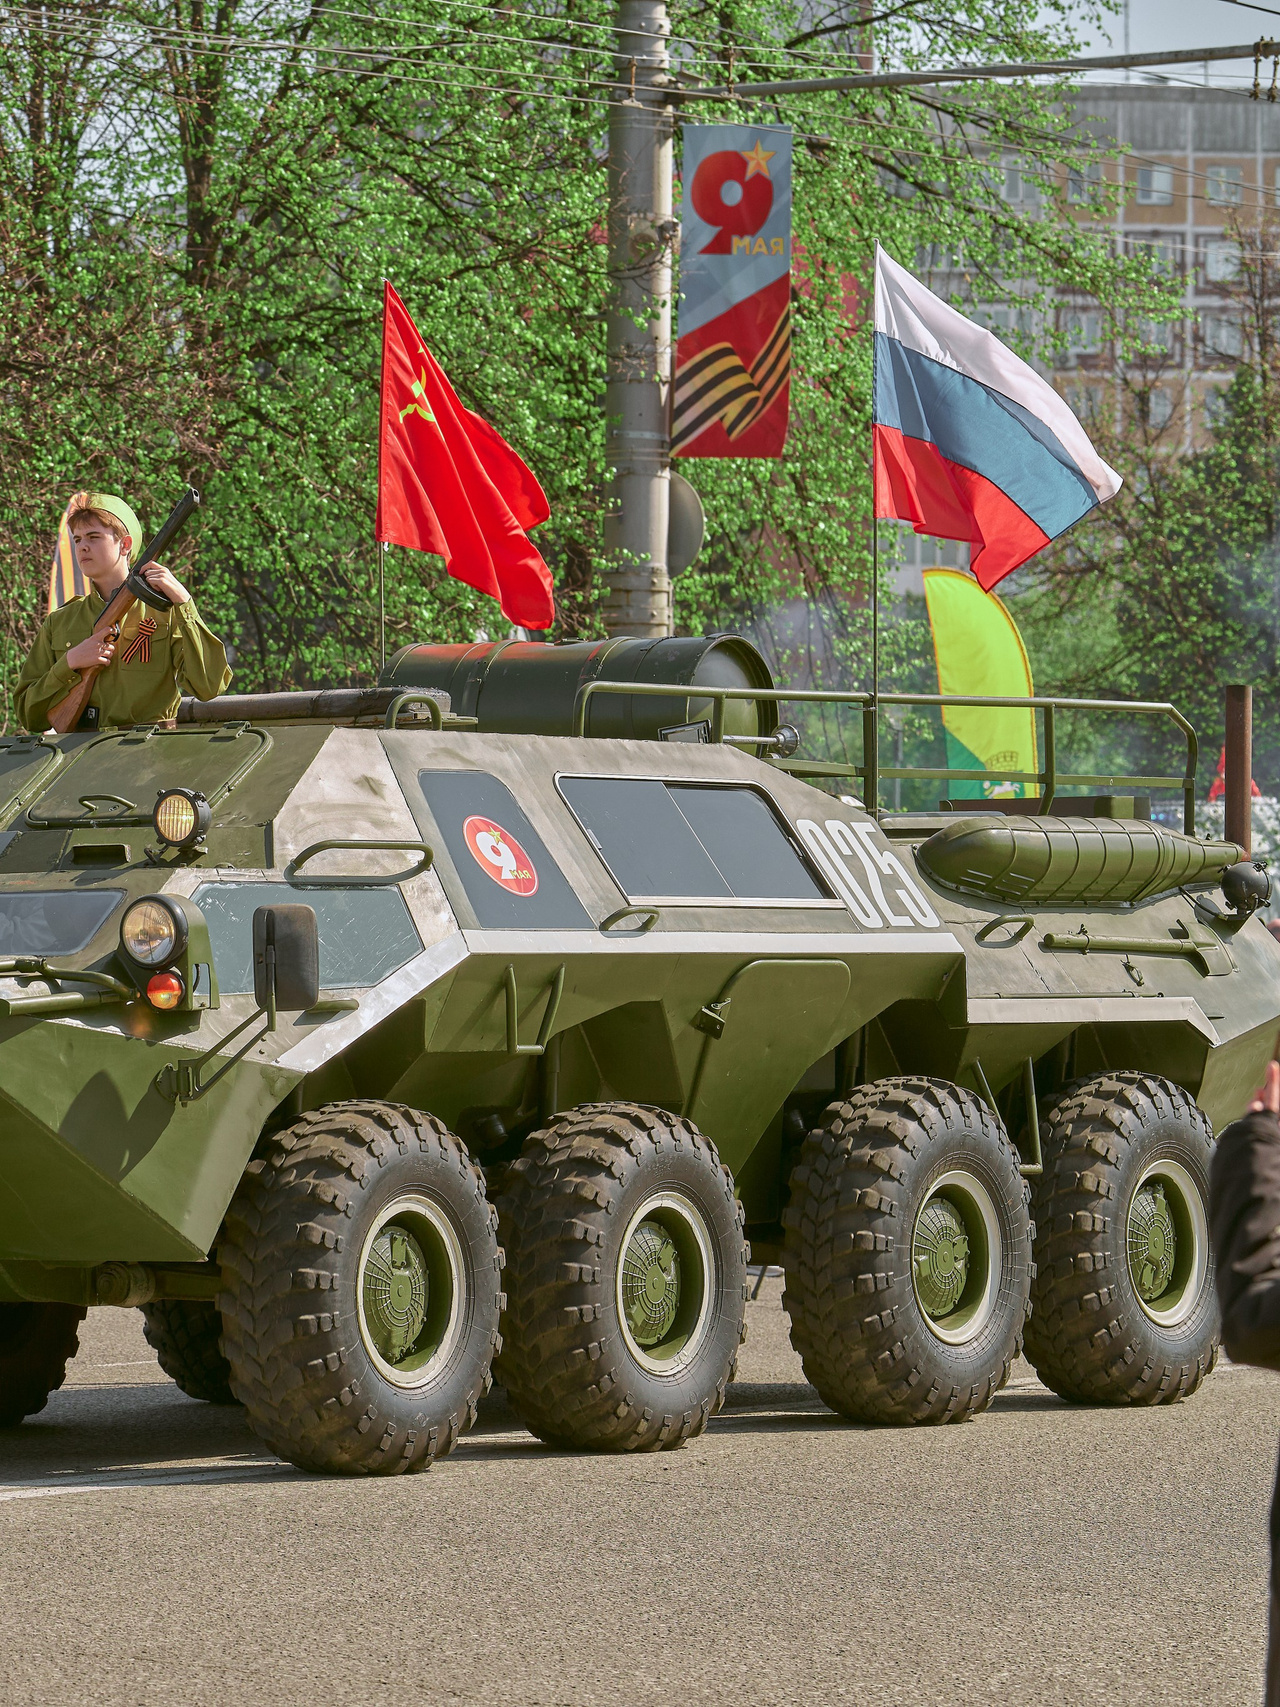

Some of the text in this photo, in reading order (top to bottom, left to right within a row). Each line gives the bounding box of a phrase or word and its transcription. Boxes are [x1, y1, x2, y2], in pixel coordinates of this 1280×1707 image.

[691, 150, 774, 255] 9
[732, 236, 784, 255] МАЯ
[475, 831, 517, 880] 9
[509, 869, 532, 880] МАЯ
[796, 819, 940, 928] 025
